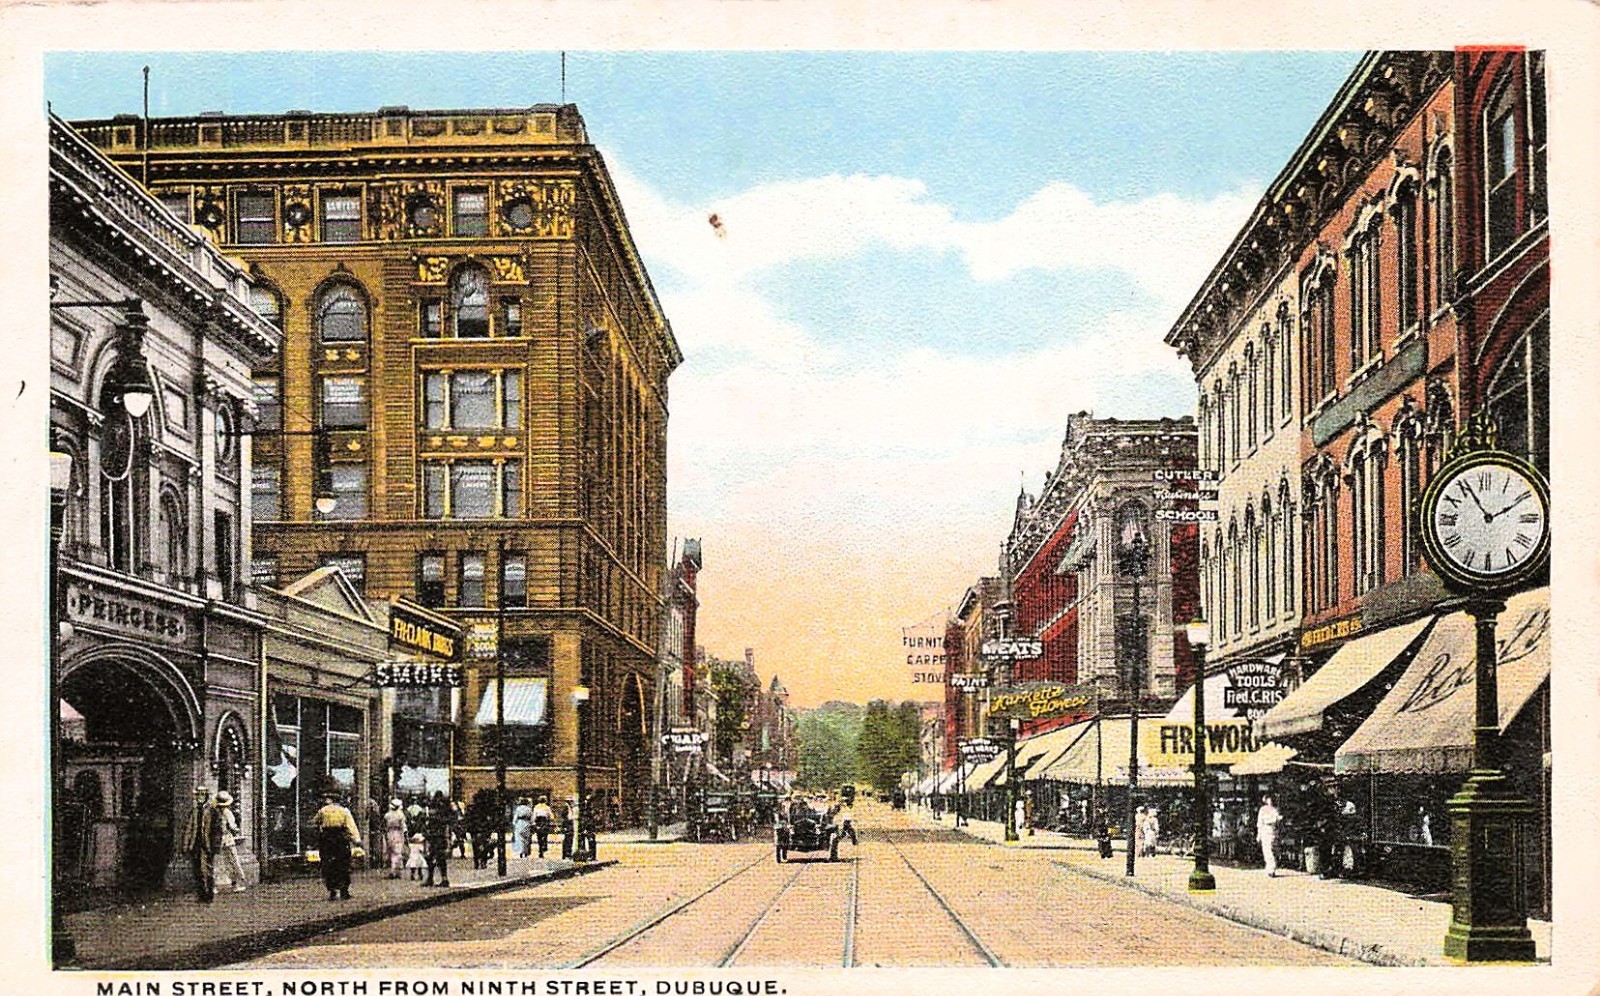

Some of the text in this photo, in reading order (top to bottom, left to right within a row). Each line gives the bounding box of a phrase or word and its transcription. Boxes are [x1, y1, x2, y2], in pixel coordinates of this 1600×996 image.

[1155, 470, 1213, 480] CUTLER
[1155, 510, 1215, 520] SCHOOL
[79, 594, 180, 638] PRINCESS
[903, 637, 947, 648] FURNIT
[982, 642, 1042, 655] MEATS
[377, 664, 459, 685] SMOKE
[951, 678, 987, 686] PAINT
[1236, 676, 1276, 687] TOOLS
[1160, 724, 1261, 754] FIRWOR
